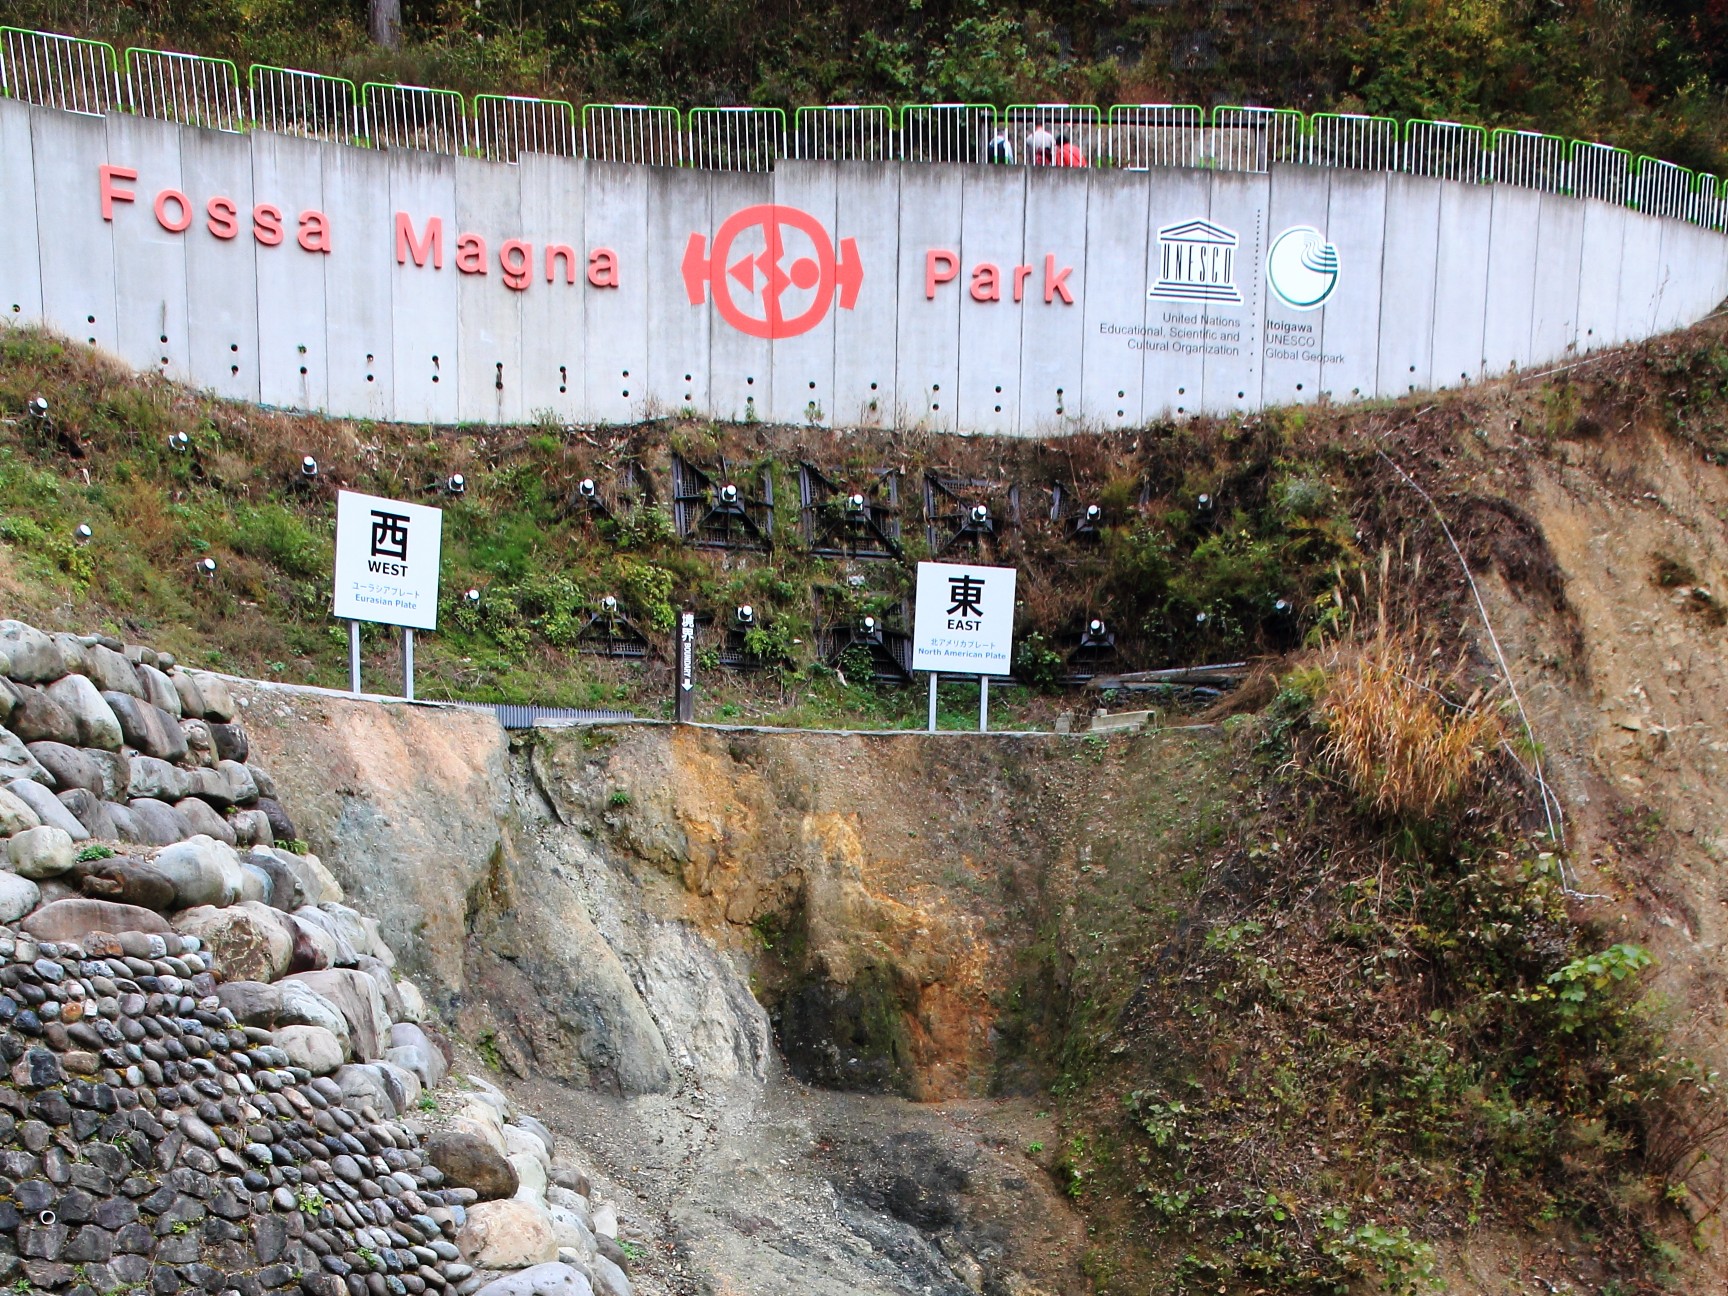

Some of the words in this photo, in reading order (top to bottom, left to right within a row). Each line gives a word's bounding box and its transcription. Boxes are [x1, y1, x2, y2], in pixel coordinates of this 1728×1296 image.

[99, 165, 332, 253] Fossa
[396, 211, 620, 290] Magna
[925, 249, 1074, 306] Park
[1163, 243, 1231, 284] UNESCO
[1162, 312, 1198, 325] United
[1202, 315, 1241, 328] Nations
[1266, 320, 1313, 335] Itoigawa
[1100, 323, 1166, 338] Educational,
[1169, 327, 1218, 340] Scientific
[1220, 332, 1240, 342] and
[1266, 334, 1315, 348] UNESCO
[1127, 339, 1169, 352] Cultural
[1172, 341, 1239, 357] Organization
[1265, 348, 1299, 361] Global
[1302, 351, 1345, 366] Geopark
[371, 510, 410, 561] 西
[367, 560, 409, 577] WEST
[355, 594, 393, 607] Eurasian
[395, 599, 417, 610] Plate
[946, 574, 985, 617] 東
[682, 614, 694, 641] 境界
[947, 619, 982, 631] EAST
[918, 648, 942, 656] North
[944, 649, 983, 658] American
[985, 651, 1006, 660] Plate
